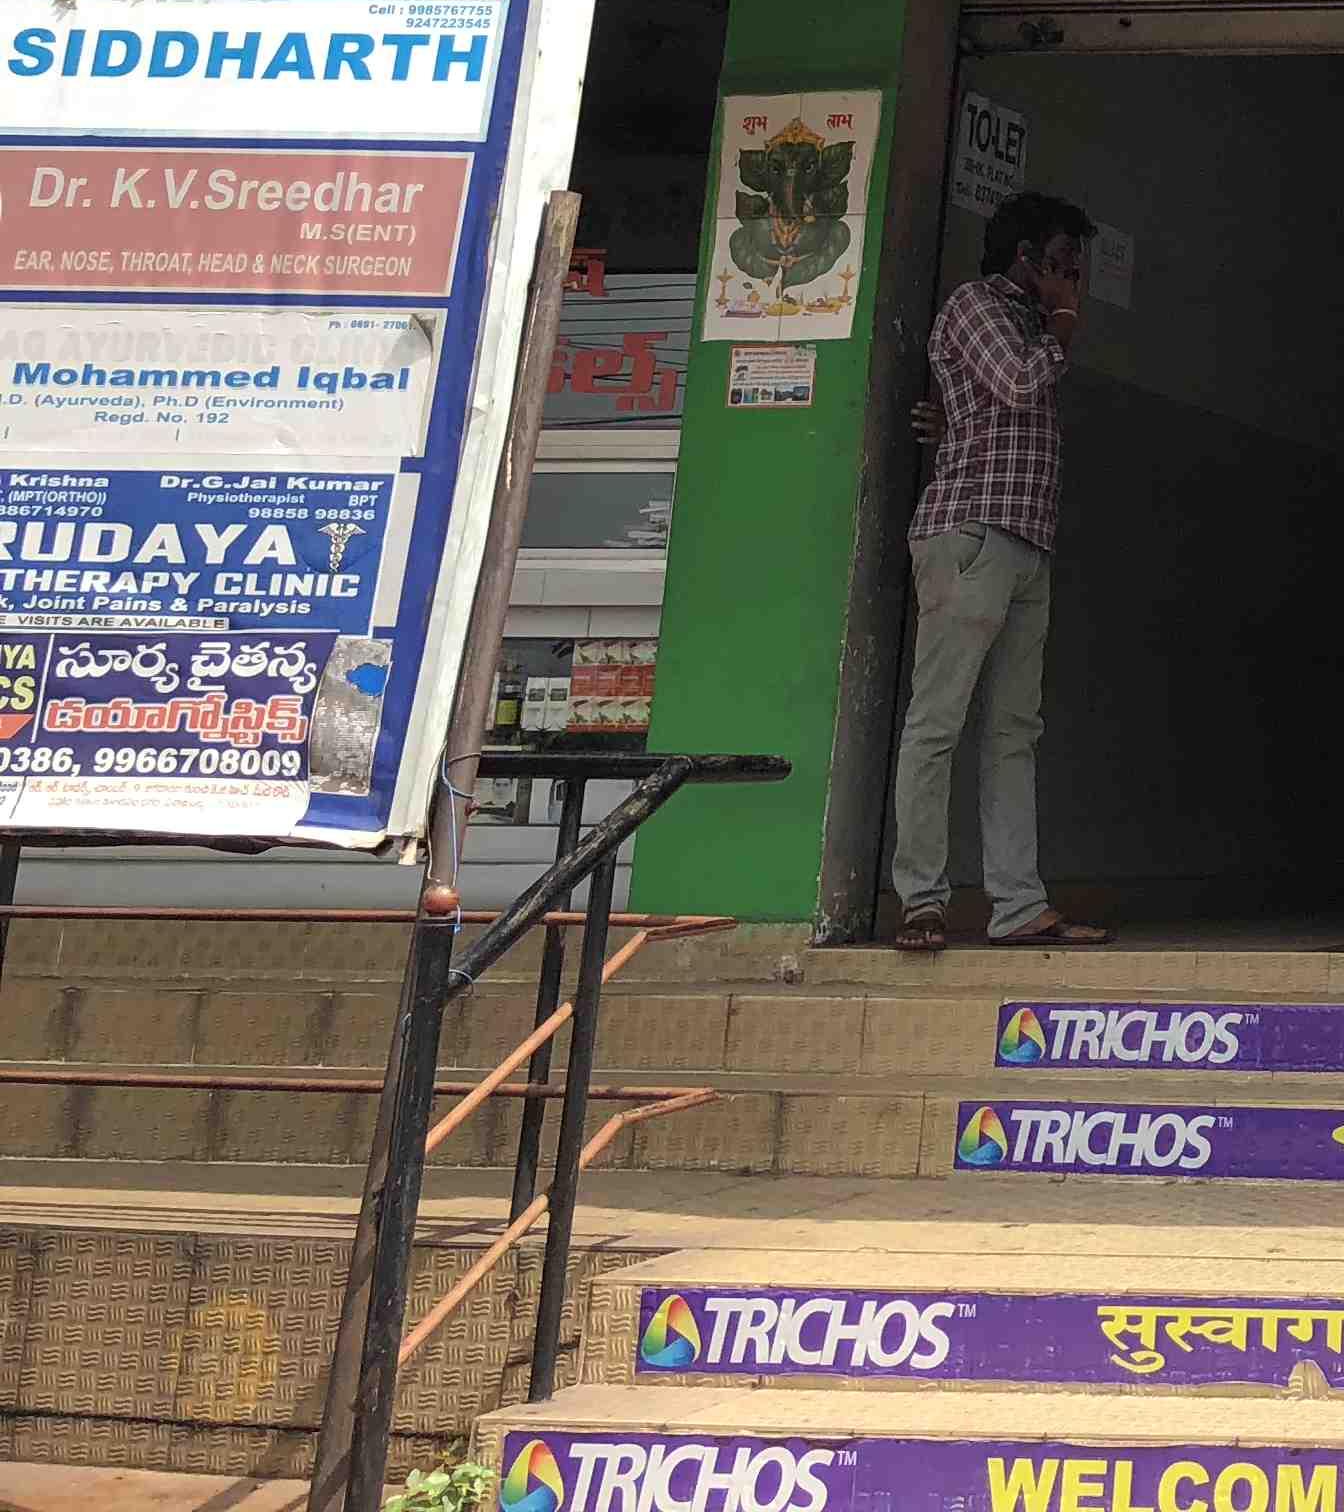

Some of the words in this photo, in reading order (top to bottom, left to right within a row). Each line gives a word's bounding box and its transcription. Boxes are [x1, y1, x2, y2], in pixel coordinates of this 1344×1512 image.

[7, 27, 489, 82] SIDDHARTH
[29, 167, 91, 208] Dr.
[110, 168, 424, 214] K.V.Sreedhar
[300, 223, 416, 245] M.S(ENT)
[198, 253, 248, 273] HEAD
[252, 255, 266, 273] &
[271, 254, 321, 275] NECK
[325, 255, 411, 277] SURGEON
[13, 363, 280, 388] Mohammed
[298, 367, 409, 393] Iqbal
[205, 395, 344, 412] (Environment)
[214, 572, 360, 597] CLINIC
[197, 598, 310, 616] Paralysis
[94, 748, 301, 776] 9966708009
[1044, 1008, 1242, 1064] TRICHOS
[1008, 1108, 1214, 1168] TRICHOS
[702, 1296, 954, 1368] TRICHOS
[566, 1440, 837, 1512] TRICHOS
